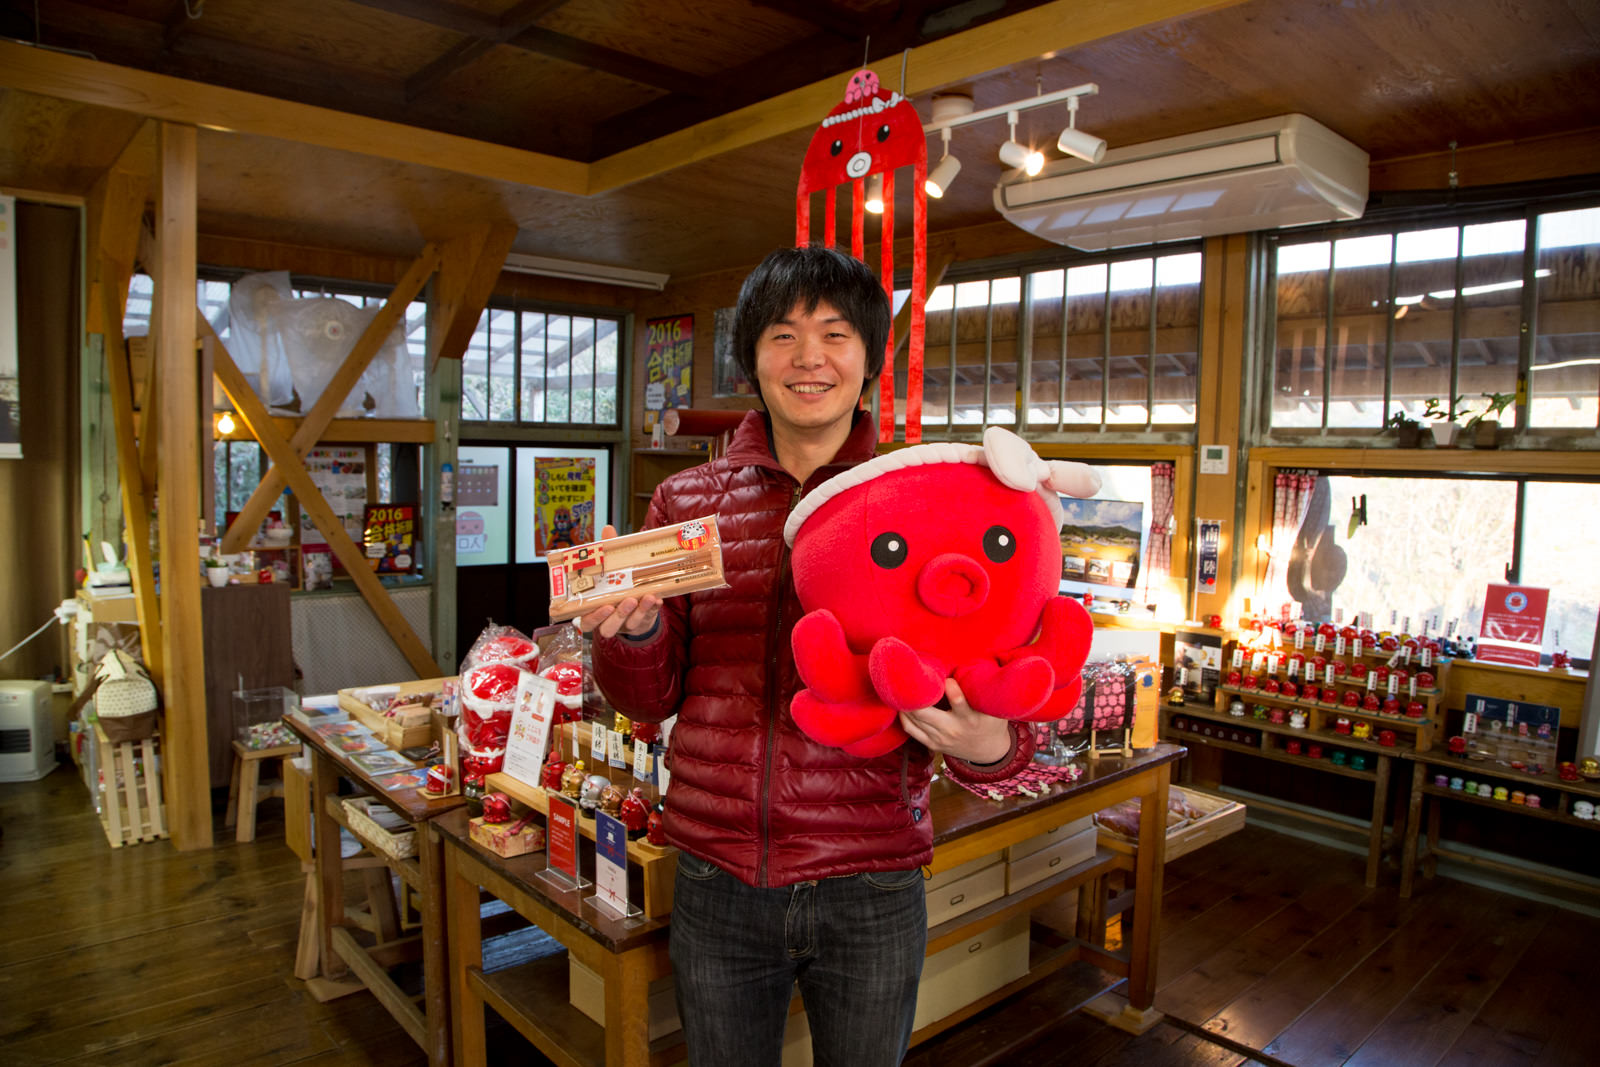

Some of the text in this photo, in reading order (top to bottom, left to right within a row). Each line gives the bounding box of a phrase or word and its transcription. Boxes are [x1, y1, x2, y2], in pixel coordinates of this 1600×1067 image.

[648, 320, 681, 345] 2016
[370, 508, 403, 522] 2016
[572, 500, 593, 518] STOP
[1203, 526, 1219, 575] 南三陸
[553, 812, 571, 828] SAMPLE
